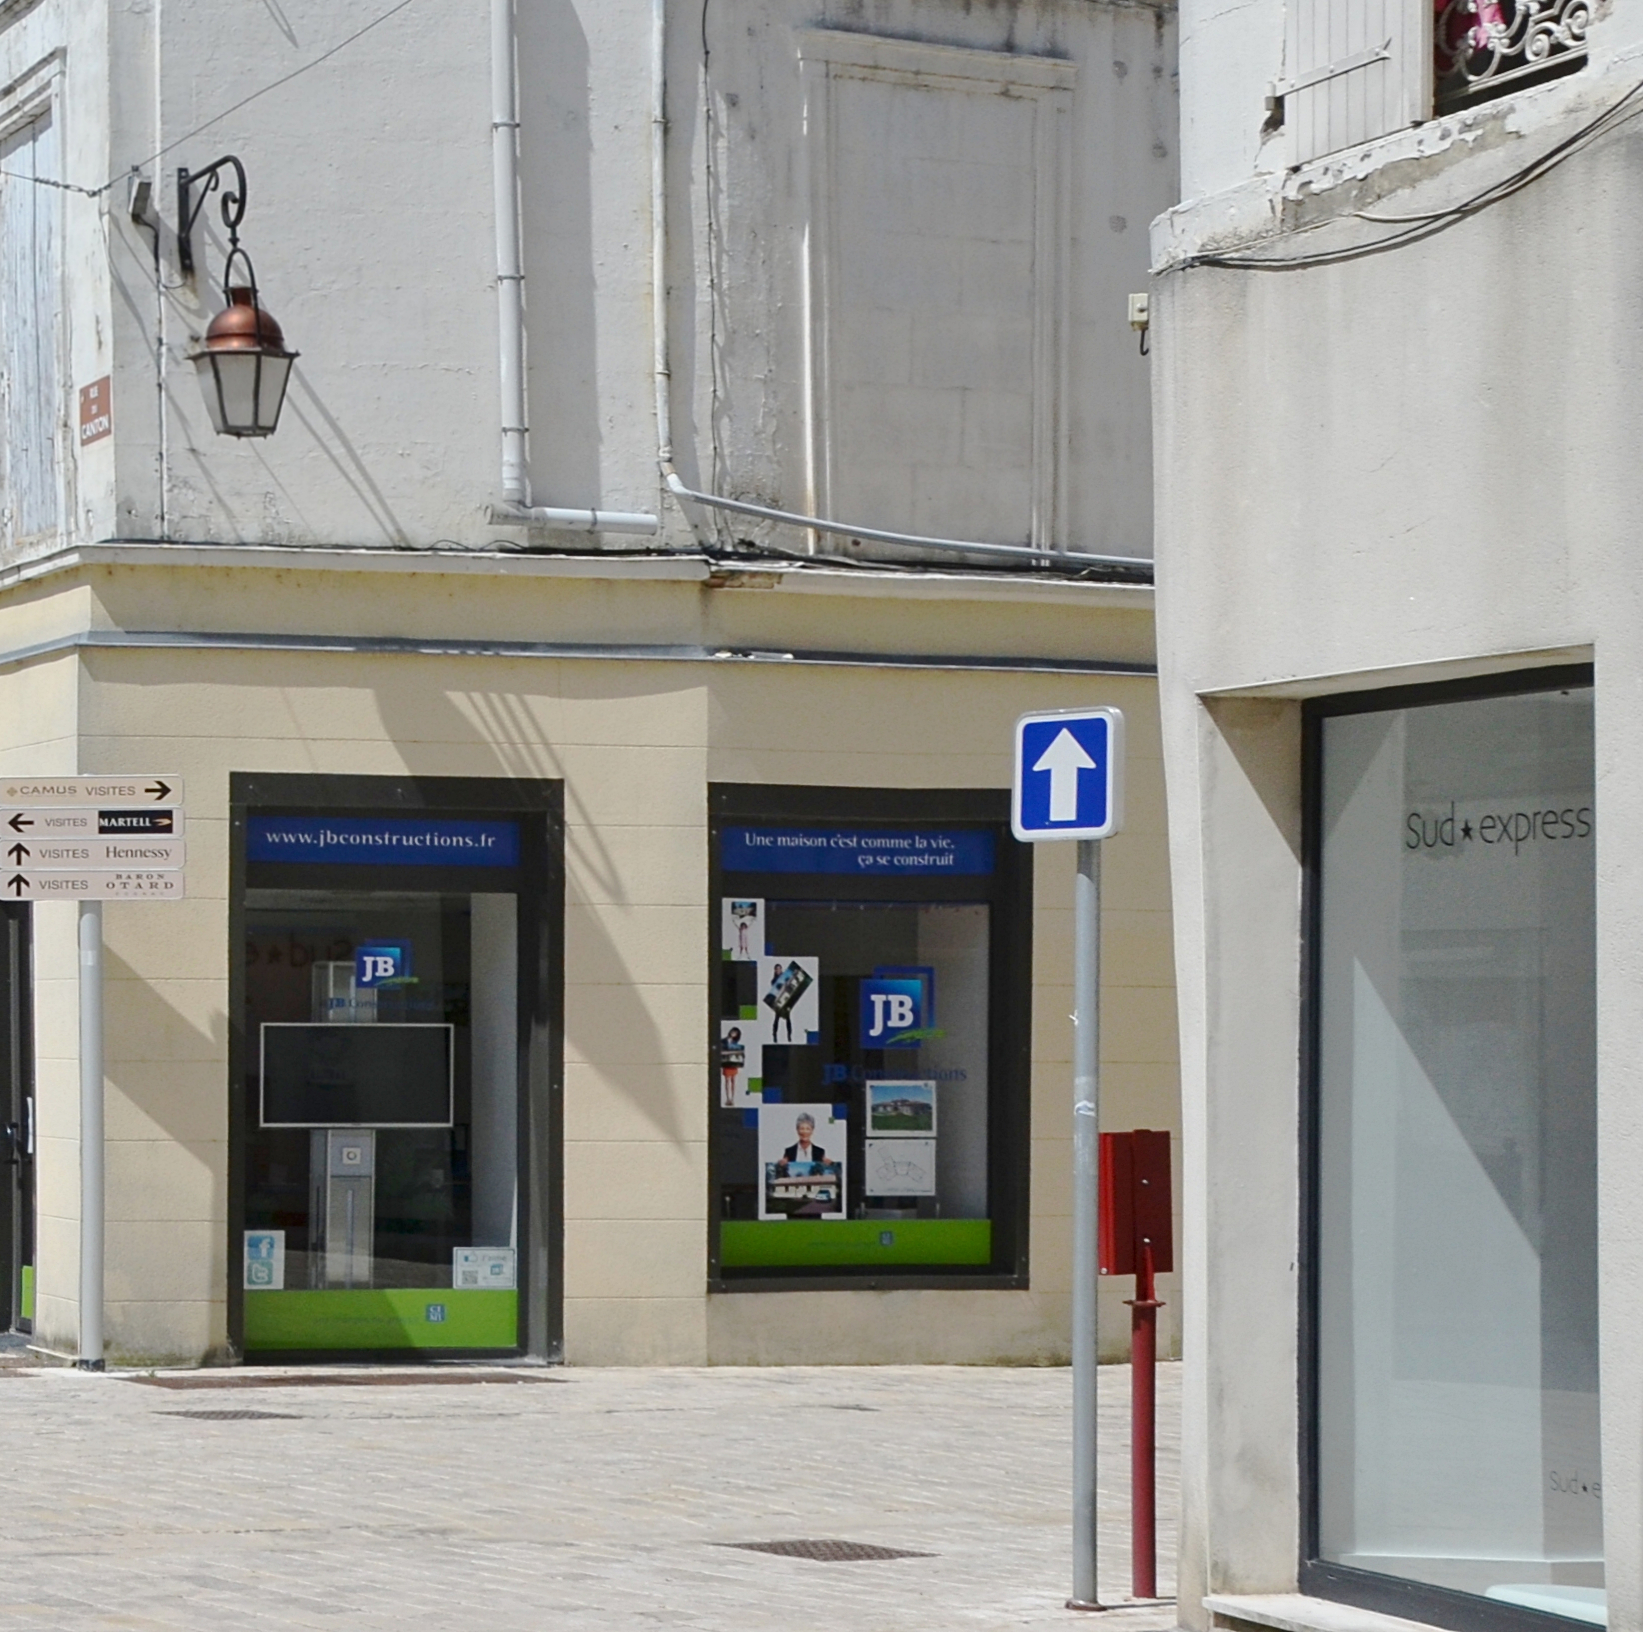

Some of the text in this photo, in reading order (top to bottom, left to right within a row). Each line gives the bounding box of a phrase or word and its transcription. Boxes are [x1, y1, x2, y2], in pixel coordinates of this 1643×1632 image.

[20, 786, 136, 796] CAMUS VISITES
[45, 817, 152, 827] VISITES MARTELL
[1406, 800, 1591, 857] Sud express
[266, 830, 496, 848] www.jbconstructions.fr
[745, 832, 774, 847] Une
[778, 834, 827, 848] maison
[830, 834, 858, 848] c'est
[861, 837, 913, 849] comme
[915, 835, 928, 849] la
[39, 845, 173, 861] VISITES Hennessy
[858, 853, 955, 868] ça se construit
[39, 880, 89, 890] VISITES
[106, 881, 175, 890] OTARD
[361, 956, 395, 982] JB
[868, 994, 914, 1037] JB
